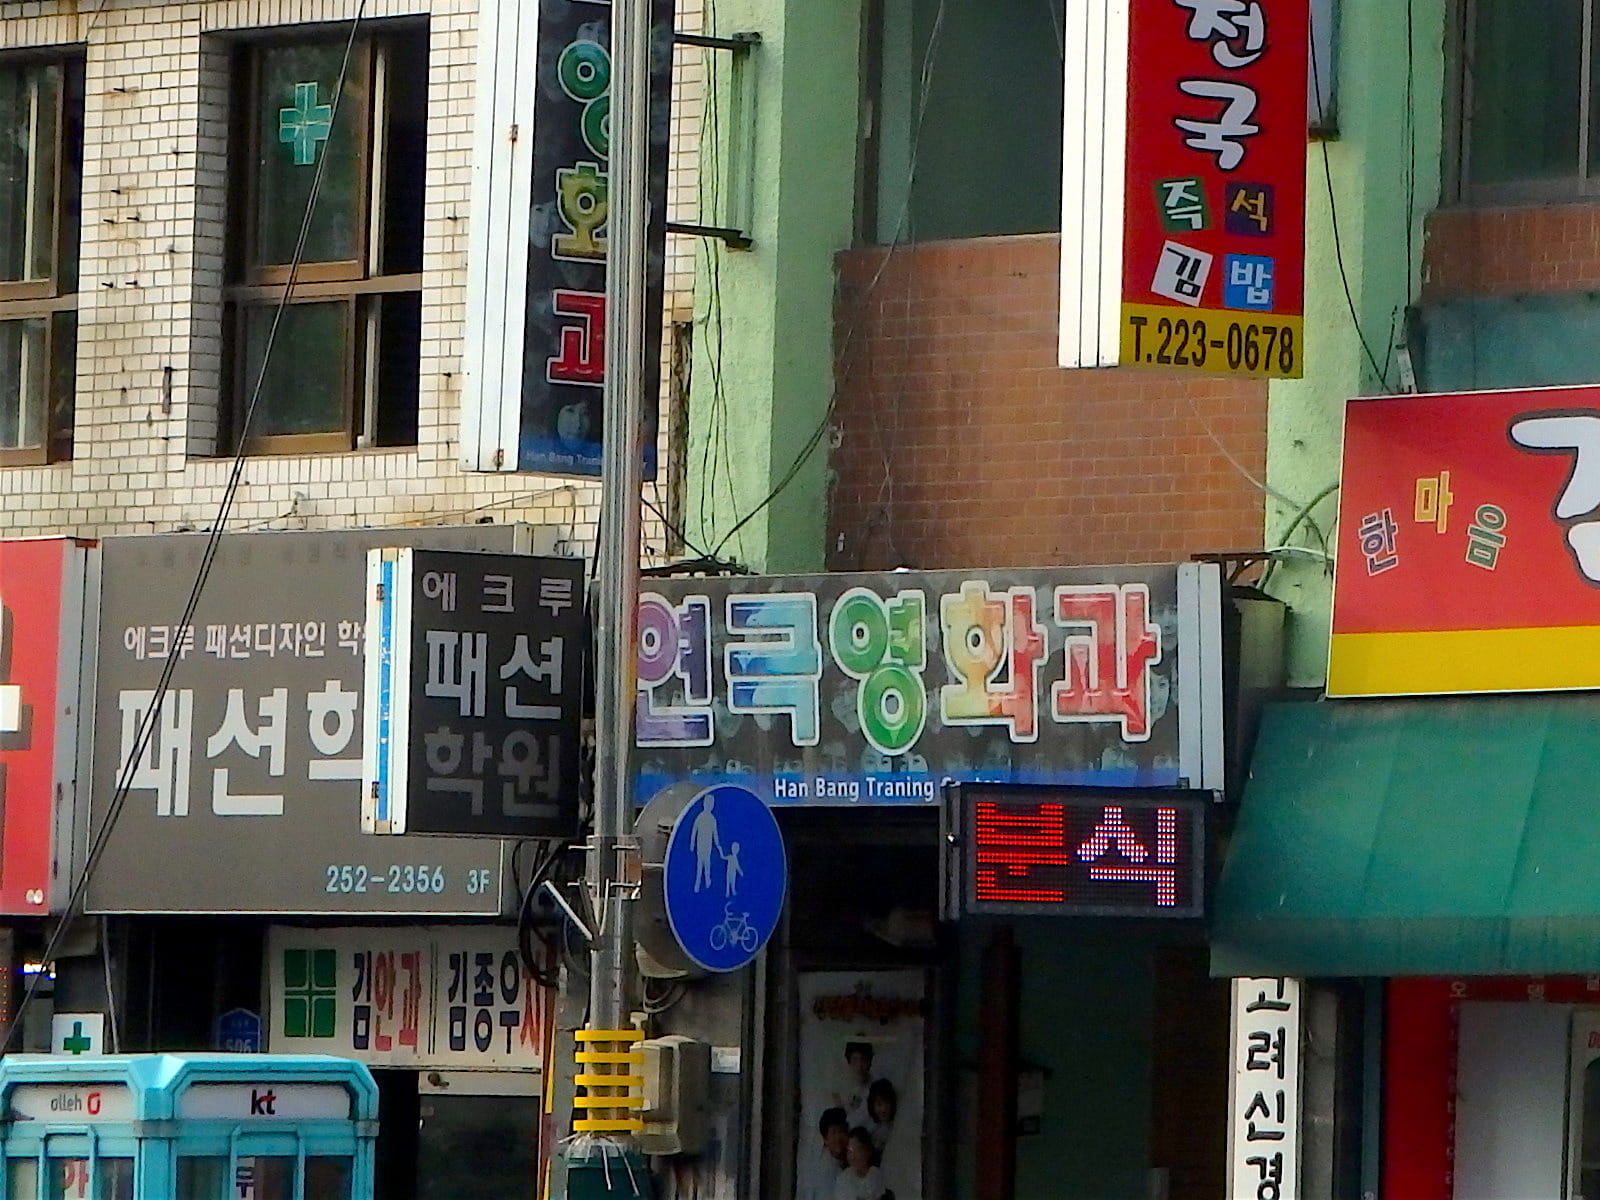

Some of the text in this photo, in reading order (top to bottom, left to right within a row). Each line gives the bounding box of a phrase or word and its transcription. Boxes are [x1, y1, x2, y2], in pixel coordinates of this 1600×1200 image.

[1162, 179, 1270, 231] 즉석
[1166, 246, 1272, 304] 김밥
[1129, 315, 1294, 372] T.223-0678
[1357, 470, 1508, 576] 한마음
[422, 570, 573, 618] 에크루
[123, 619, 367, 660] 에크루 패션디자인 학
[424, 628, 563, 720] 패션
[636, 580, 1161, 757] 연극영화과
[423, 725, 560, 820] 학원
[774, 777, 808, 798] Han
[816, 777, 859, 800] Bang
[866, 776, 934, 800] Traning
[325, 864, 491, 894] 252-2356 3F
[251, 1089, 278, 1116] kt
